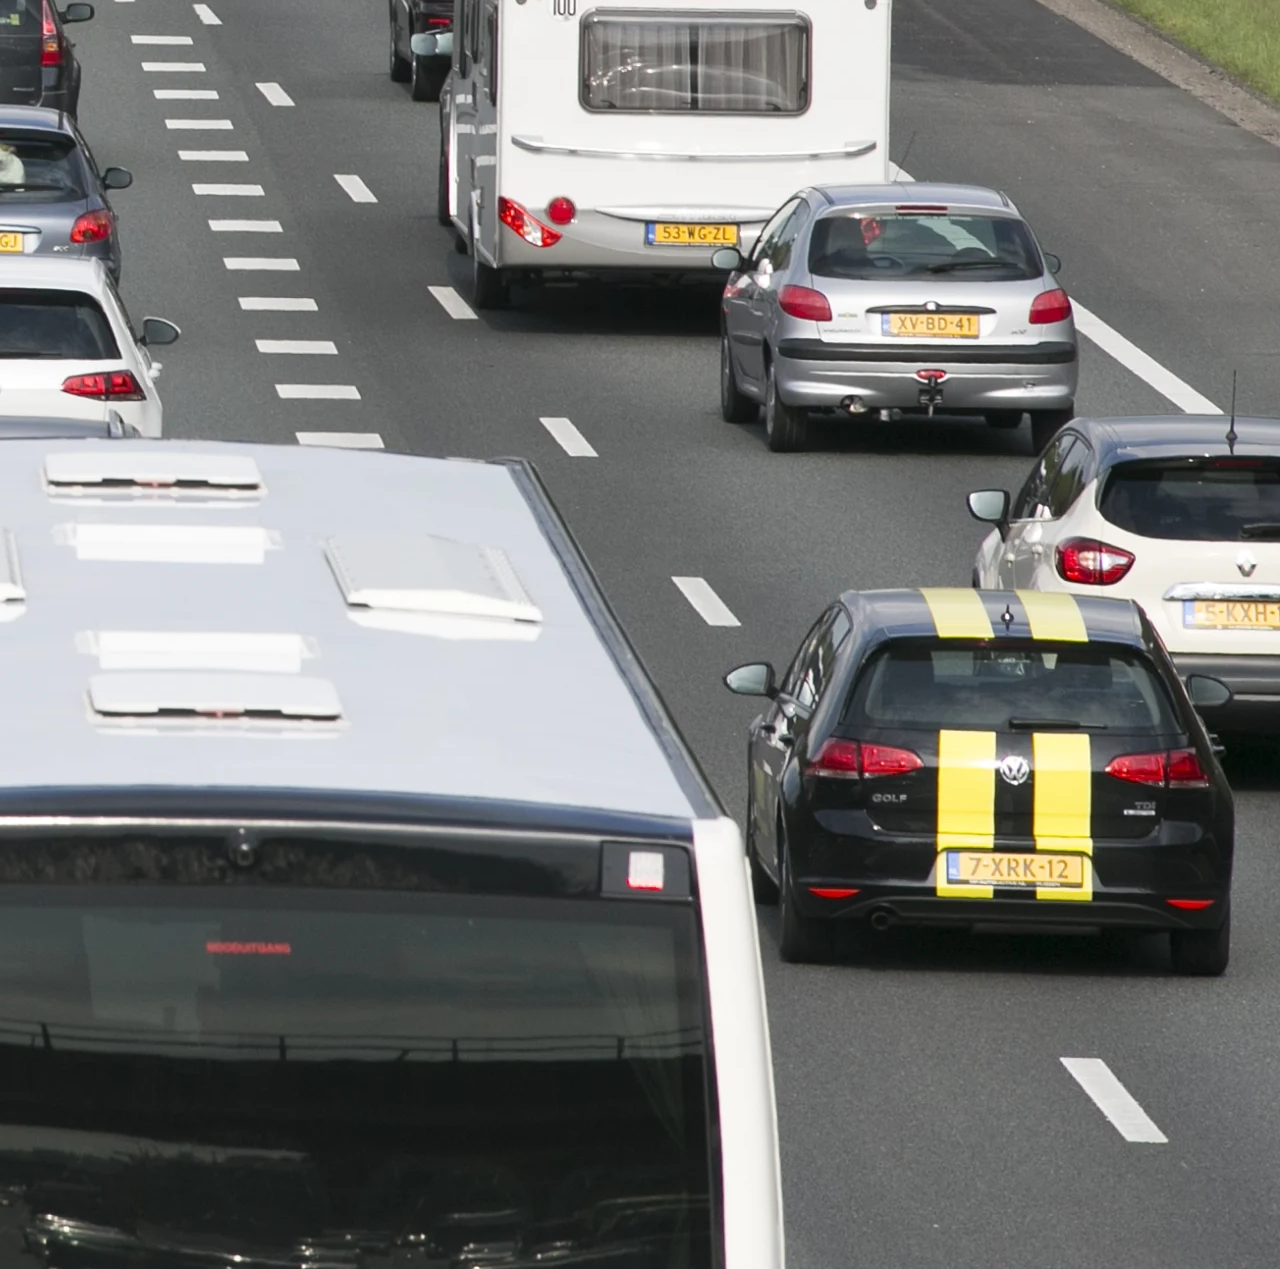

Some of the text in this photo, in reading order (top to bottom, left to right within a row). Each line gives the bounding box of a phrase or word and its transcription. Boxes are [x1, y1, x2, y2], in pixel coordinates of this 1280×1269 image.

[662, 226, 732, 241] 53-WG-ZL
[898, 316, 972, 332] XV-BD-41
[872, 793, 908, 803] GOLF
[968, 857, 1069, 880] 7-XRK-12
